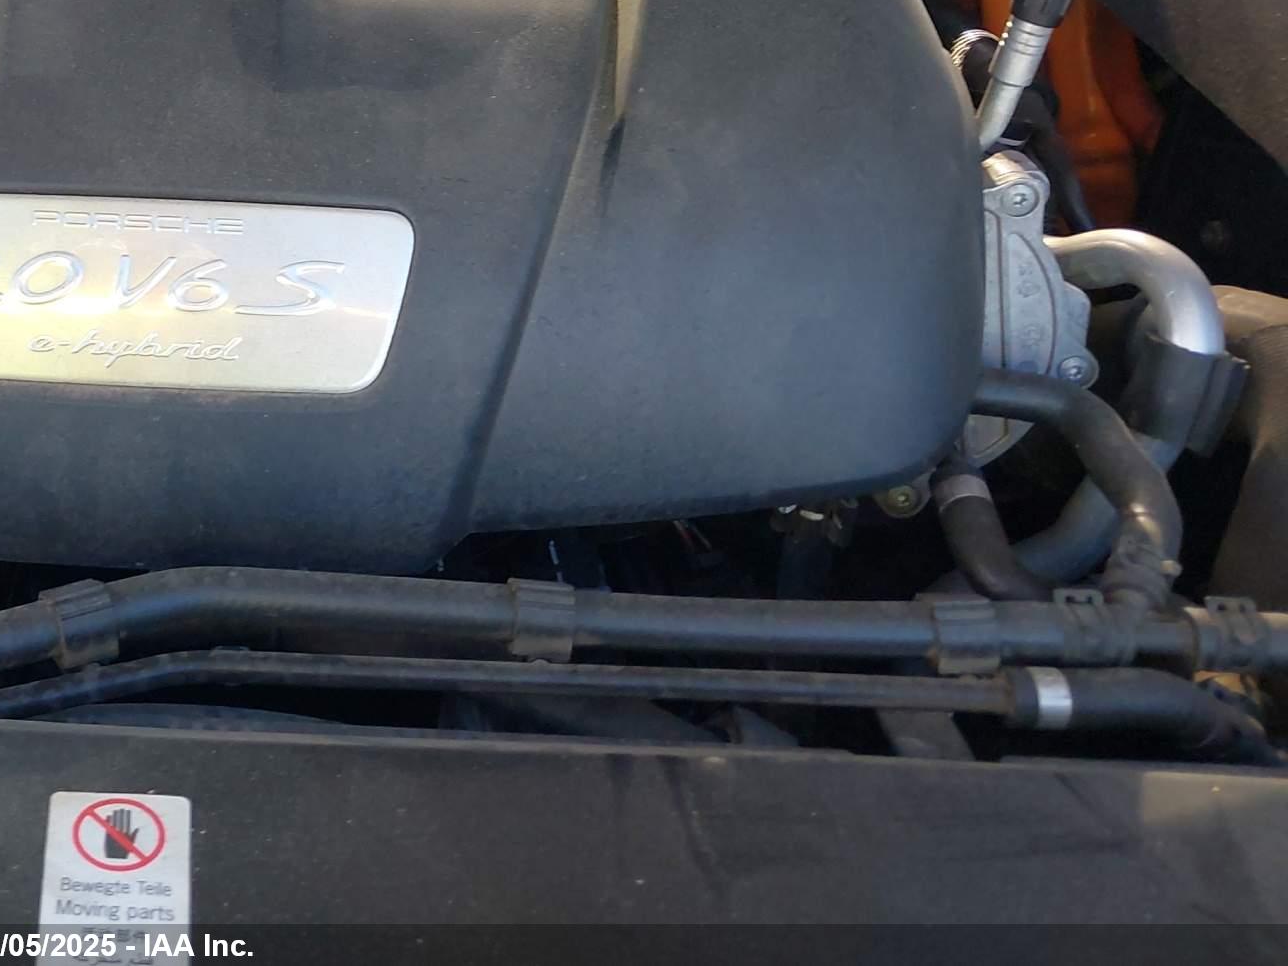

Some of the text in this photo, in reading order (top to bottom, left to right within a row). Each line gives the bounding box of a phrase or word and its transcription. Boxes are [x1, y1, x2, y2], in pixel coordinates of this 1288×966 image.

[31, 210, 245, 235] PORSCHE
[114, 254, 231, 313] V6
[234, 260, 346, 317] S
[28, 328, 243, 369] e-hybrid
[60, 876, 173, 897] Bewegte Teile
[55, 899, 175, 921] Moving parts
